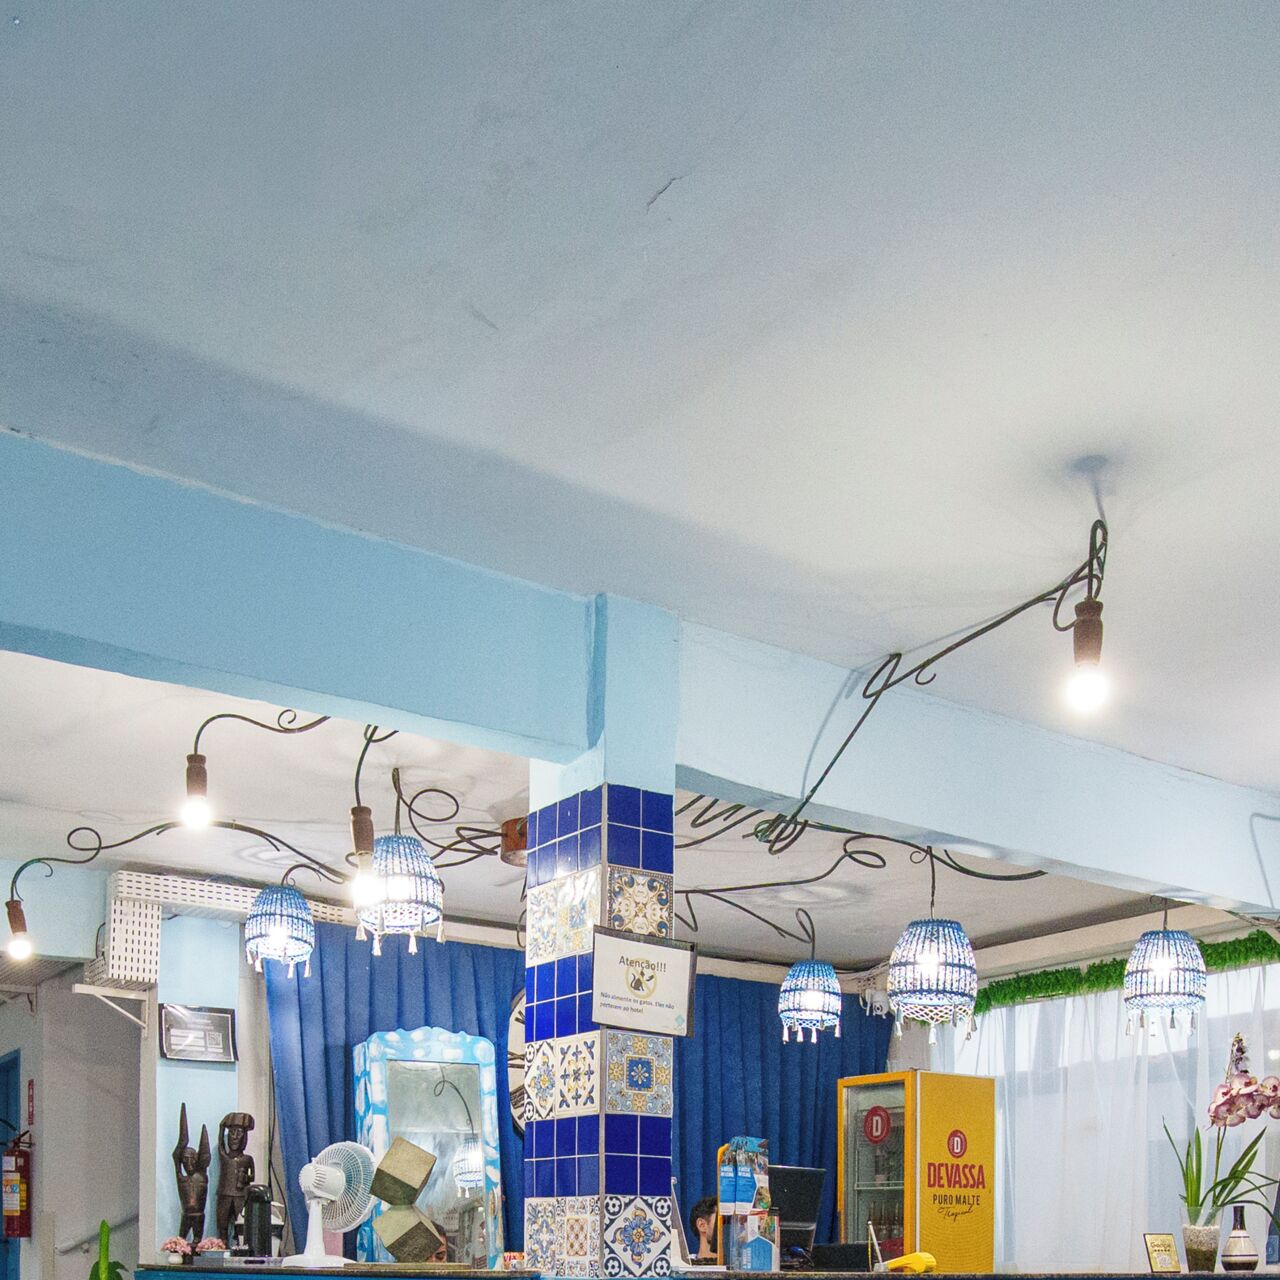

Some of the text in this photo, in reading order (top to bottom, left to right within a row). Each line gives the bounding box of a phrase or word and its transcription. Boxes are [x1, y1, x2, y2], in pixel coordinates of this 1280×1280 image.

[619, 955, 666, 972] Atenção!!!
[927, 1162, 986, 1189] DEVASSA
[933, 1193, 980, 1206] PURO MALTE
